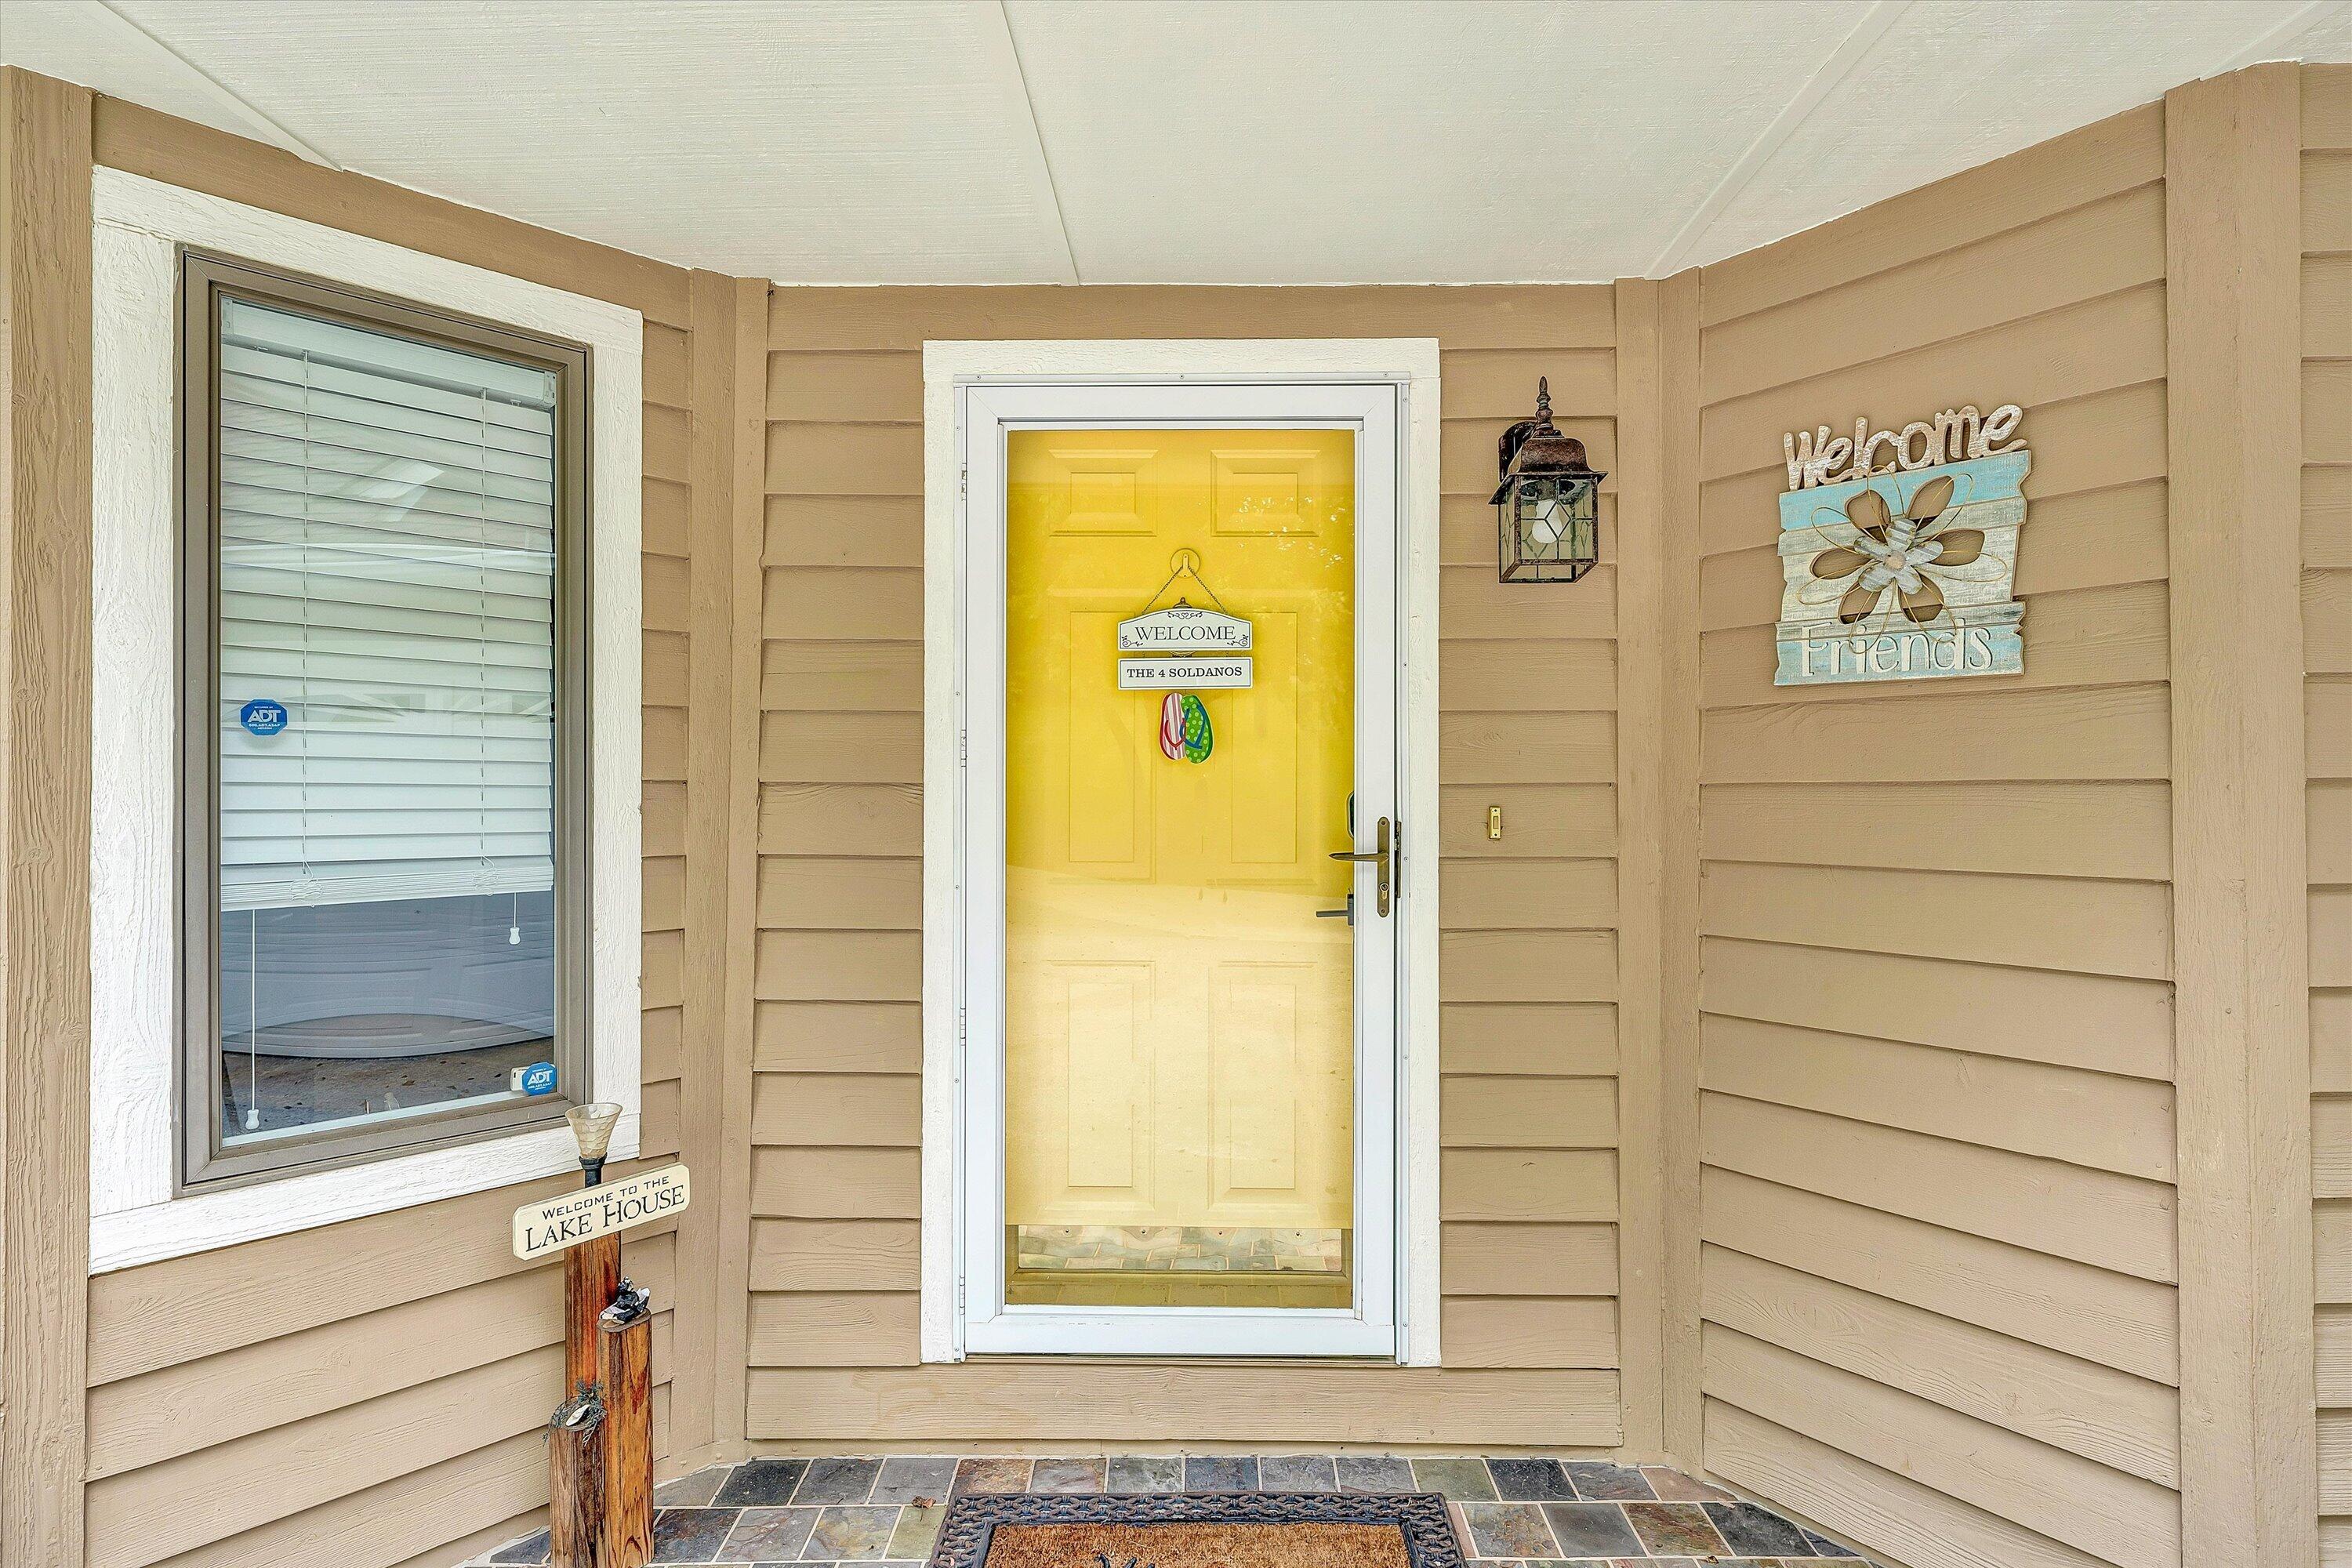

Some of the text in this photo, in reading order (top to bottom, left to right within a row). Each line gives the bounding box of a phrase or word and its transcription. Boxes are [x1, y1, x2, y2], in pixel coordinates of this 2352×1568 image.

[1783, 404, 2028, 492] Welcome
[1135, 626, 1236, 641] WELCOME
[1802, 617, 1994, 677] Friends
[1127, 666, 1243, 678] THE 4 SOLDANOS
[247, 710, 281, 723] ADT
[527, 1069, 554, 1086] ADT
[542, 1175, 670, 1221] WELCOME TO THE
[525, 1184, 685, 1252] LAKE HOUSE
